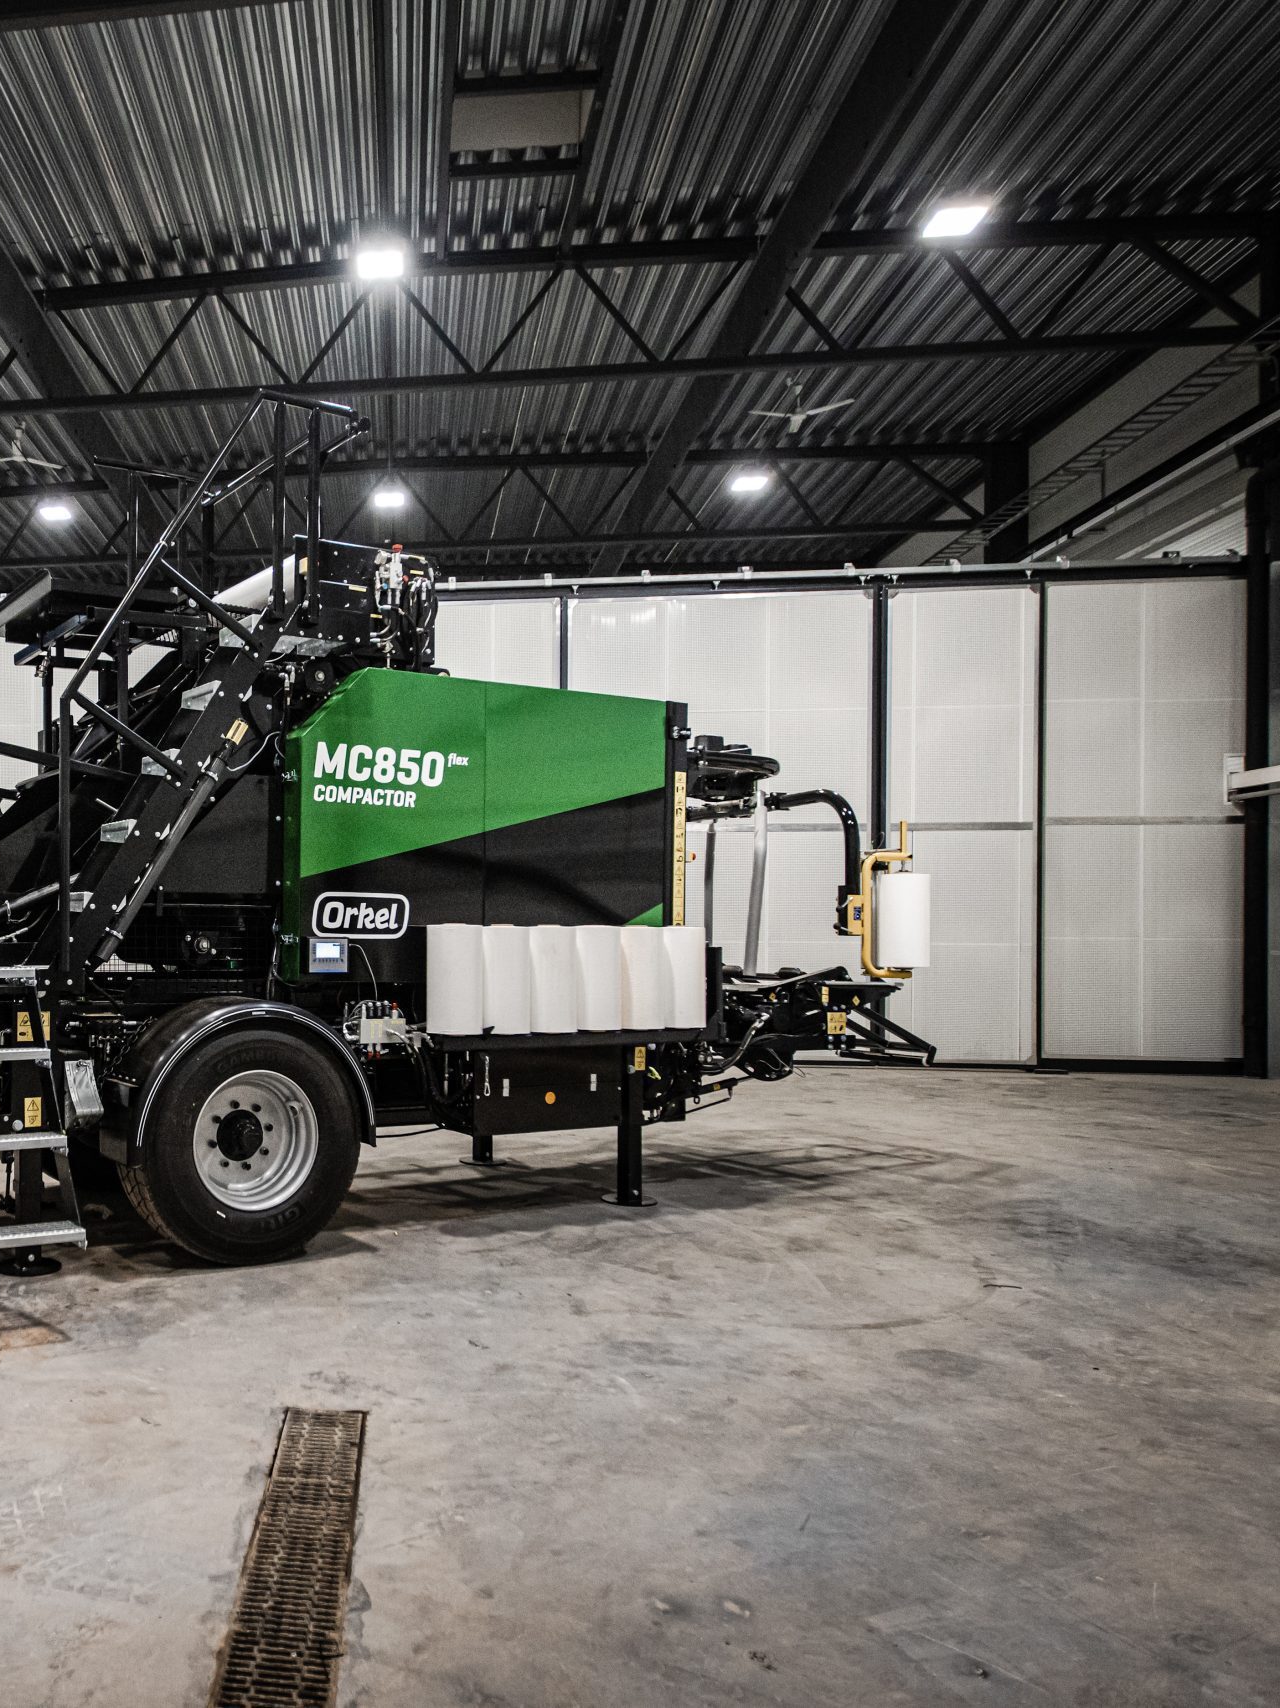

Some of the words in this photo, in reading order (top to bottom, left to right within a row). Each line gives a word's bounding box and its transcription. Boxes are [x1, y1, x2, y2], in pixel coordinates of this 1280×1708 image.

[313, 741, 445, 787] MC850
[447, 753, 469, 768] flex
[313, 784, 417, 808] COMPACTOR
[322, 901, 399, 930] Orkel
